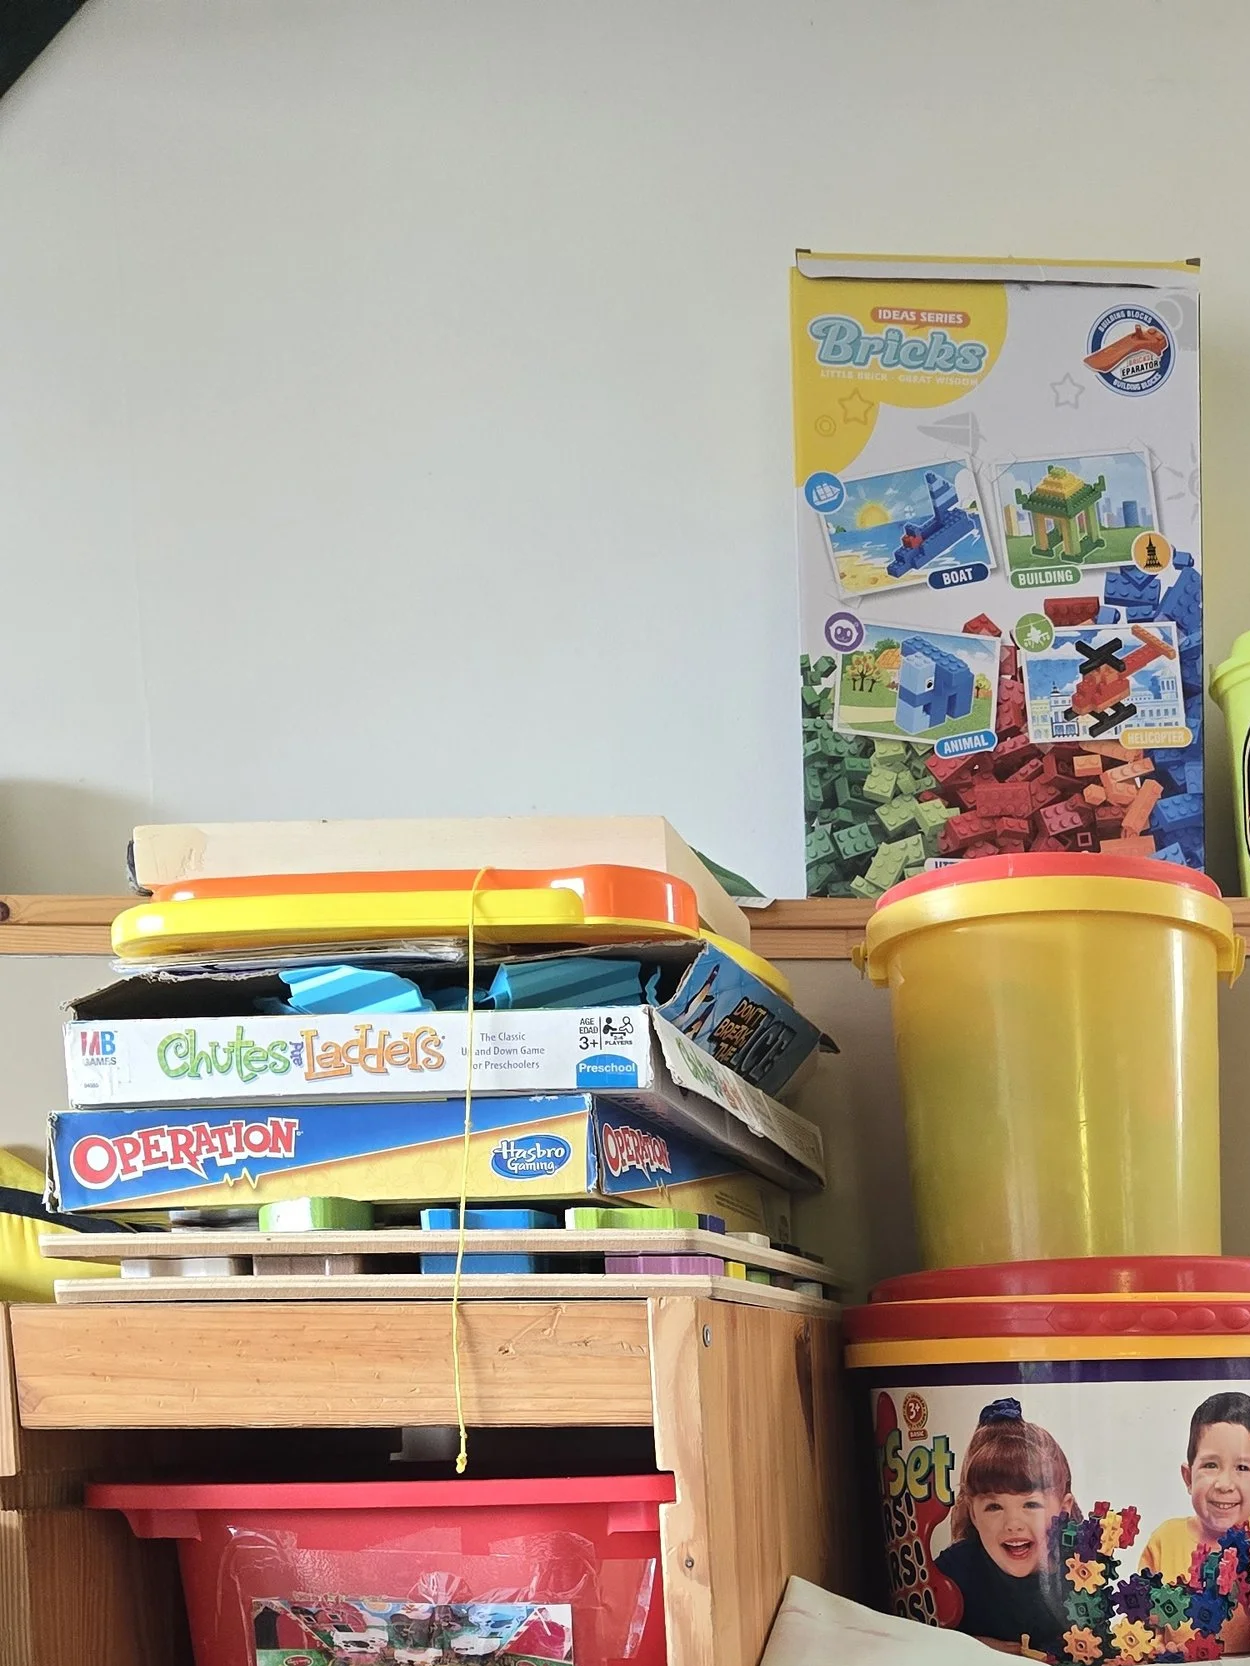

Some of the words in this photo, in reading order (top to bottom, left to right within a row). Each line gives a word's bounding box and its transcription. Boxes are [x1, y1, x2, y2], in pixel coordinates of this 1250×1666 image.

[878, 309, 917, 322] IDEAS
[920, 312, 964, 325] SERIES
[1097, 311, 1126, 333] BUILDING
[1126, 310, 1153, 324] BLOCKS
[809, 315, 988, 374] Bricks
[820, 369, 855, 379] LITTLE
[942, 567, 973, 586] BOAT
[1018, 569, 1074, 586] BUILDING
[943, 733, 990, 755] ANIMAL
[1126, 731, 1185, 745] HELICOPTER
[579, 1018, 595, 1026] AGE
[735, 999, 767, 1027] DON'T
[479, 1032, 497, 1042] The
[498, 1032, 526, 1042] Classic
[579, 1026, 599, 1034] EDAD
[713, 1018, 754, 1047] BREAK
[80, 1030, 117, 1057] MB
[474, 1046, 492, 1056] and
[493, 1046, 518, 1056] Down
[520, 1046, 545, 1056] Game
[578, 1036, 599, 1050] 3+
[714, 1041, 738, 1064] THE
[731, 1016, 797, 1082] ICE
[157, 1025, 292, 1083] Chutes
[293, 1041, 305, 1067] and
[300, 1023, 446, 1082] Ladders
[484, 1060, 540, 1071] Preschoolers
[579, 1062, 636, 1073] Preschool
[71, 1118, 299, 1186] OPERATION
[491, 1140, 566, 1162] Hasbro
[602, 1122, 672, 1179] OPERATION
[506, 1156, 558, 1173] Gaming
[908, 1402, 921, 1420] 3+
[886, 1428, 955, 1506] Set
